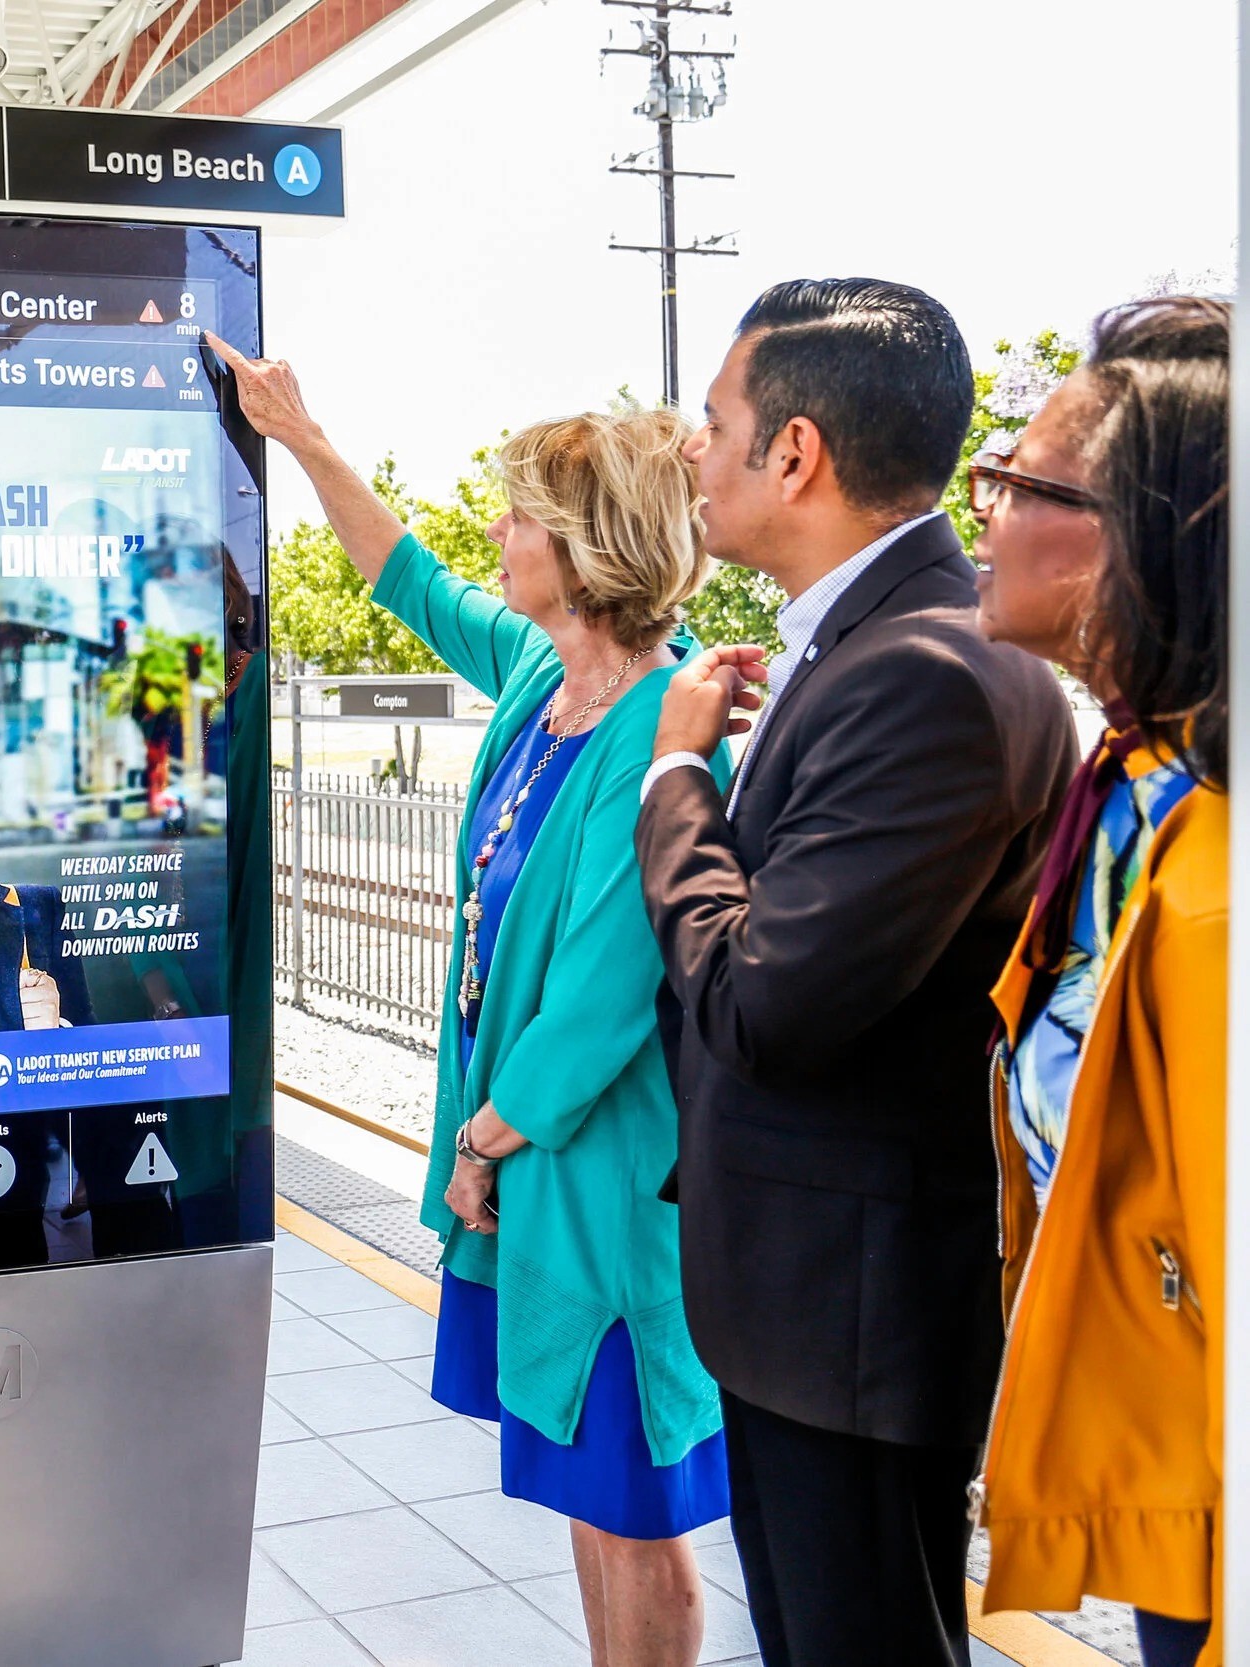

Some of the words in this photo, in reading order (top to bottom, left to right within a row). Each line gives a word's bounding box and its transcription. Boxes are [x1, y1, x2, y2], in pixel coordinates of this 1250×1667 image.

[87, 144, 163, 183] Long
[173, 149, 265, 182] Beach
[287, 156, 309, 185] A
[1, 291, 98, 321] Center
[180, 292, 196, 319] 8
[176, 322, 201, 336] min
[34, 358, 136, 388] Towers
[182, 357, 199, 384] 9
[179, 388, 203, 401] min
[101, 447, 191, 472] LADOT
[373, 693, 408, 711] Compton
[61, 856, 127, 876] WEEKDAY
[127, 853, 183, 873] SERVICE
[61, 884, 102, 903] UNTIL
[104, 882, 135, 901] 9PM
[137, 881, 158, 899] ON
[60, 912, 86, 931] ALL
[93, 904, 182, 931] DASH
[61, 935, 145, 958] DOWNTOWN
[147, 932, 200, 953] ROUTES
[16, 1055, 52, 1071] LADOT
[53, 1051, 99, 1069] TRANSIT
[102, 1049, 127, 1065] NEW
[128, 1046, 171, 1063] SERVICE
[172, 1043, 201, 1059] PLAN
[17, 1073, 36, 1085] Your
[37, 1071, 59, 1083] Ideas
[60, 1069, 77, 1081] and
[78, 1068, 94, 1080] Our
[95, 1065, 147, 1079] Commitment
[134, 1112, 168, 1125] Alerts
